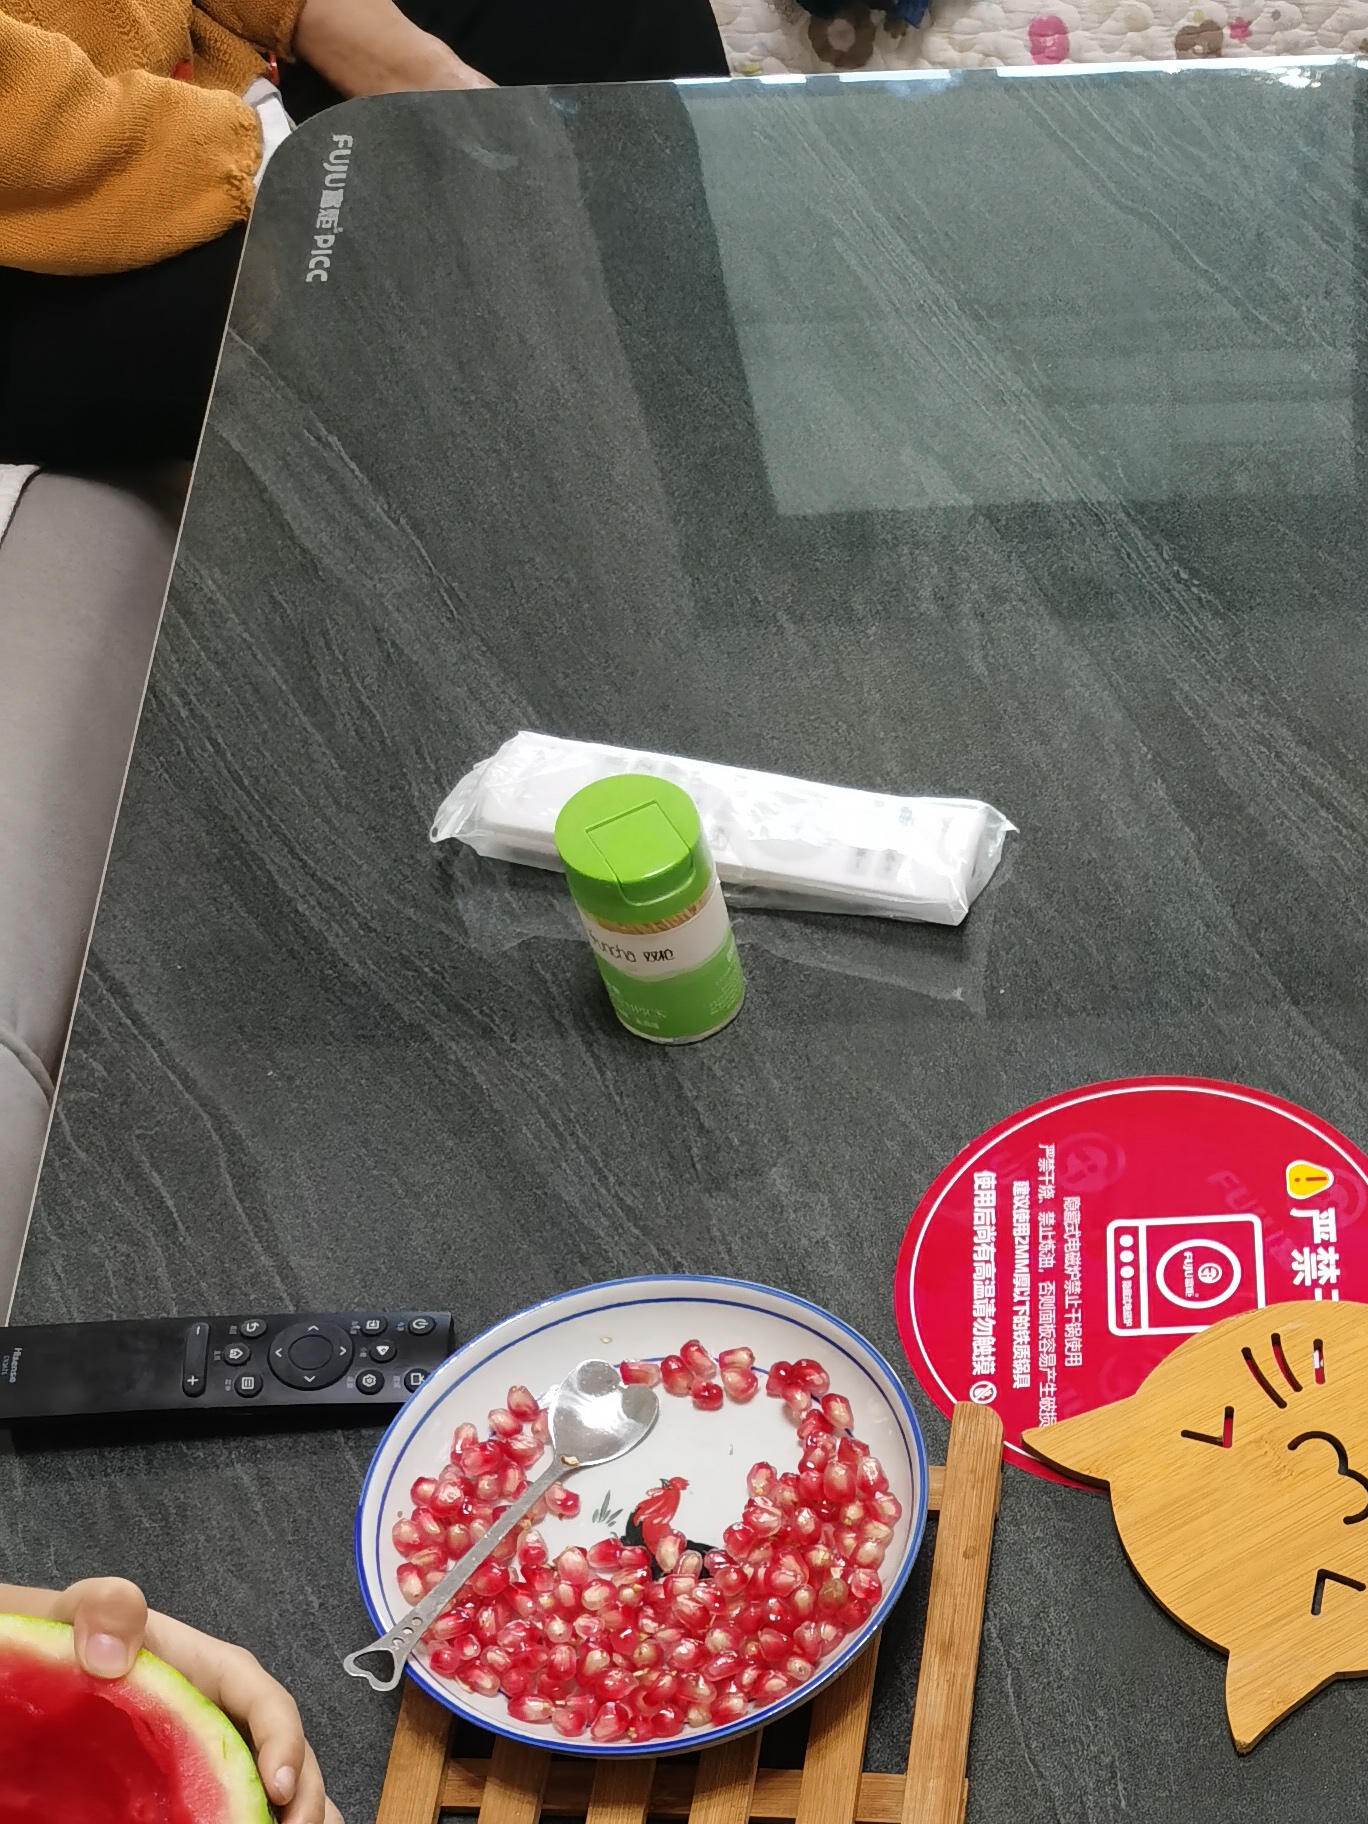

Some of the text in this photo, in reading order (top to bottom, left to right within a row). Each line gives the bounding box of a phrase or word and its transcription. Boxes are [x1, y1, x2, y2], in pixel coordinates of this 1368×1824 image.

[305, 233, 335, 282] PICC
[971, 1170, 996, 1375] 使用后尚有高温请勿触摸
[1012, 1180, 1029, 1388] 建议使用2MM厚以下的铁质锅具
[1062, 1196, 1081, 1366] 隐藏式电磁炉禁止干锅使用
